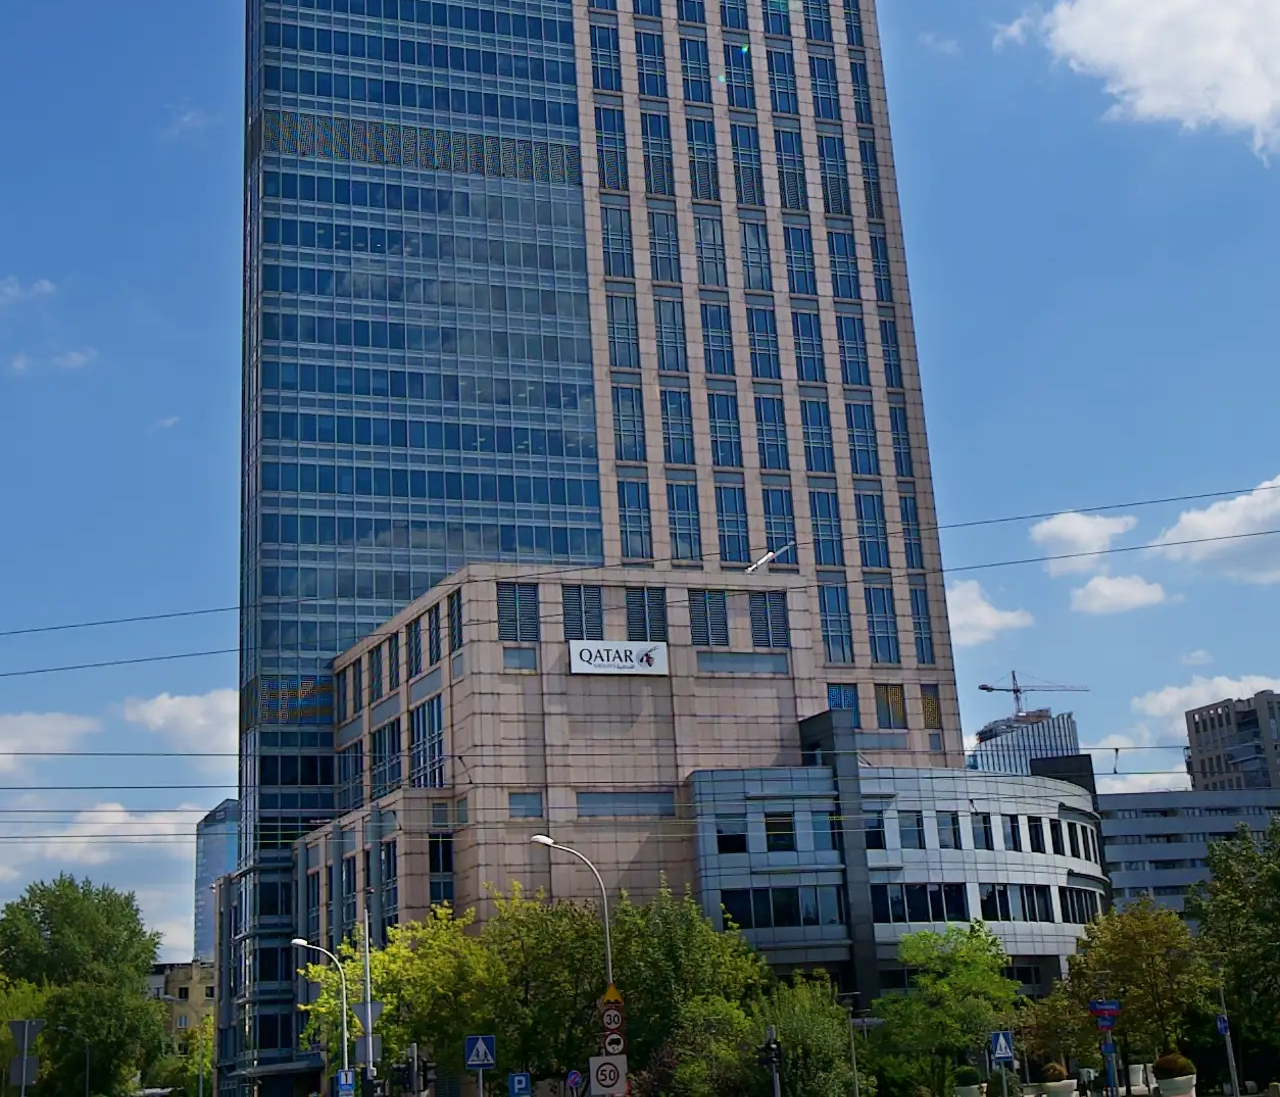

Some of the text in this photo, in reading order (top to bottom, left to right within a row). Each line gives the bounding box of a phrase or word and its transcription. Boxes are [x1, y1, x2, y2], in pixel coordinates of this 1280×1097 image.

[579, 648, 634, 665] QATAR
[605, 1013, 620, 1025] 30
[599, 1069, 616, 1082] 50
[514, 1075, 526, 1093] P
